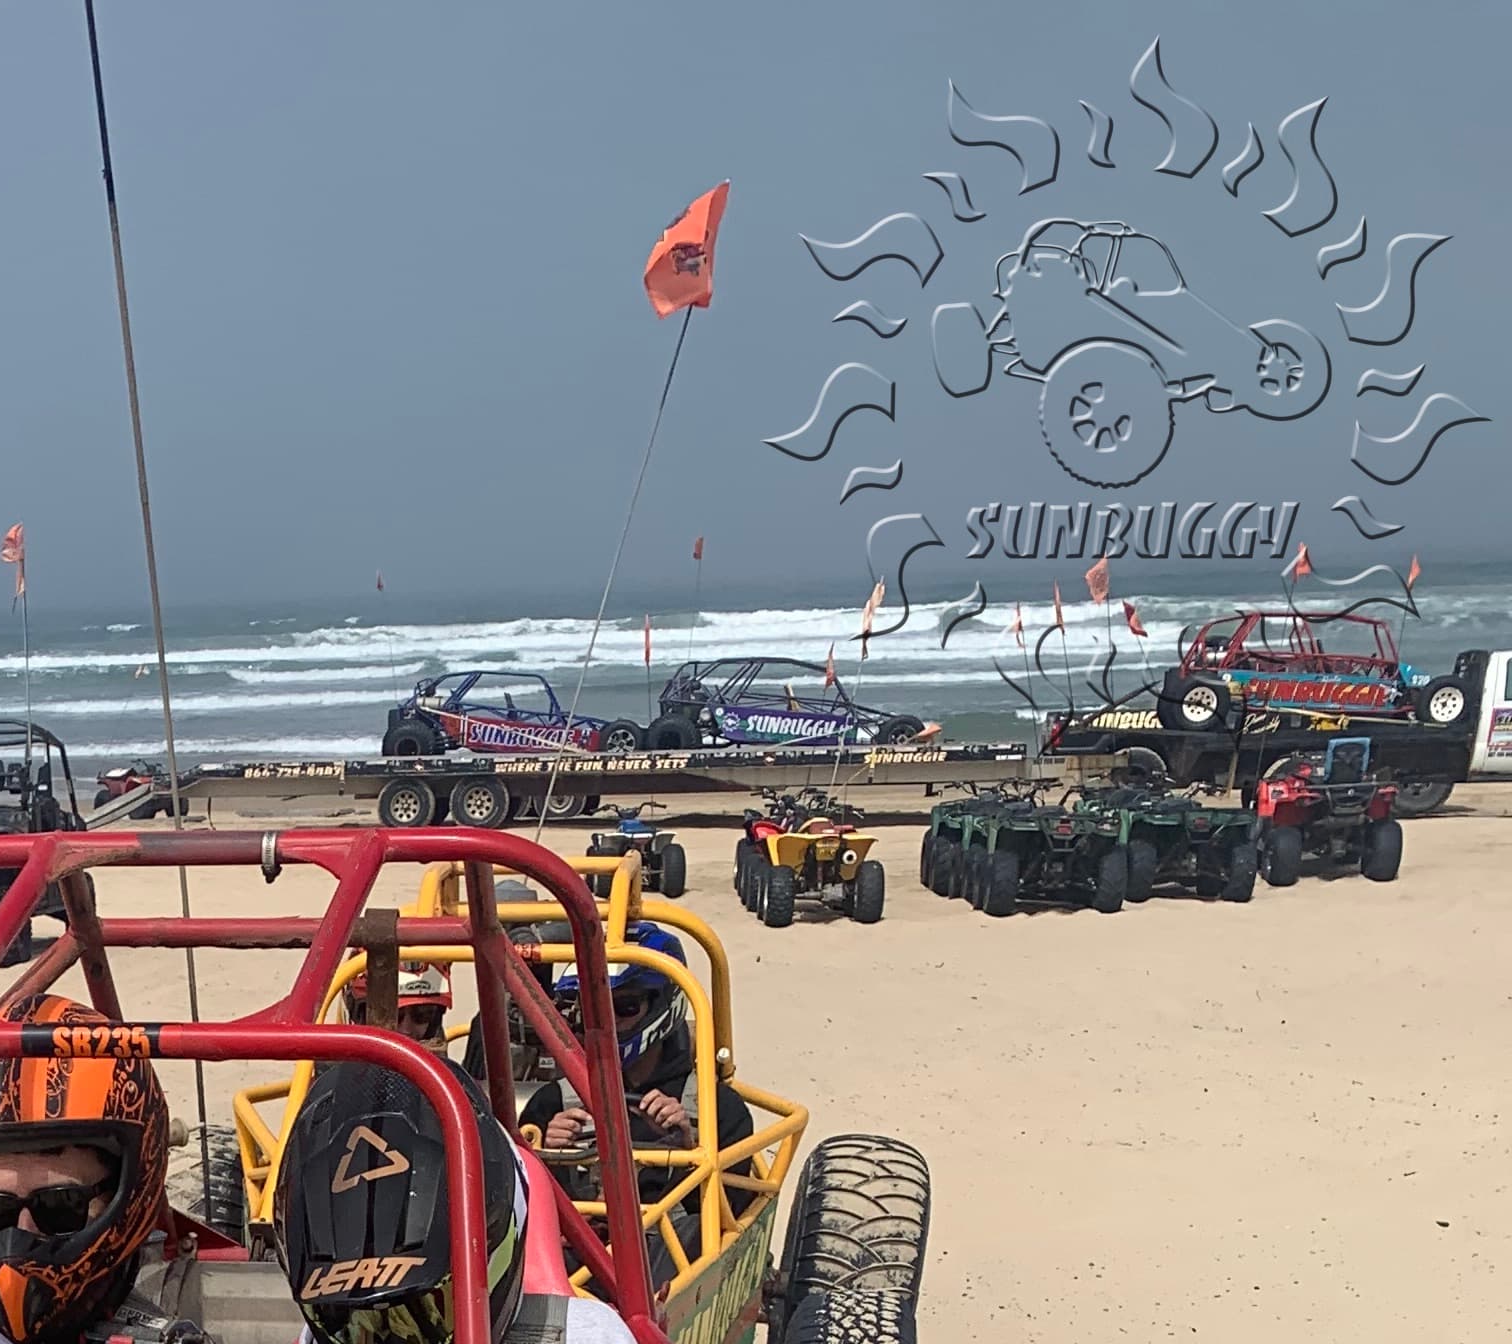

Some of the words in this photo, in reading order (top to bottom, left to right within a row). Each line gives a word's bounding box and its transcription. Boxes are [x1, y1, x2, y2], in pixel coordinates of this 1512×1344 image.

[747, 715, 837, 737] SUNBUGGY
[495, 761, 542, 773] WHERE
[547, 761, 571, 772] THE
[575, 760, 603, 772] FUN
[607, 759, 651, 771] NEVER
[655, 758, 688, 769] SETS
[863, 751, 948, 764] SUNBUGGIE
[53, 1026, 151, 1058] SB235
[300, 1256, 428, 1300] LEATT
